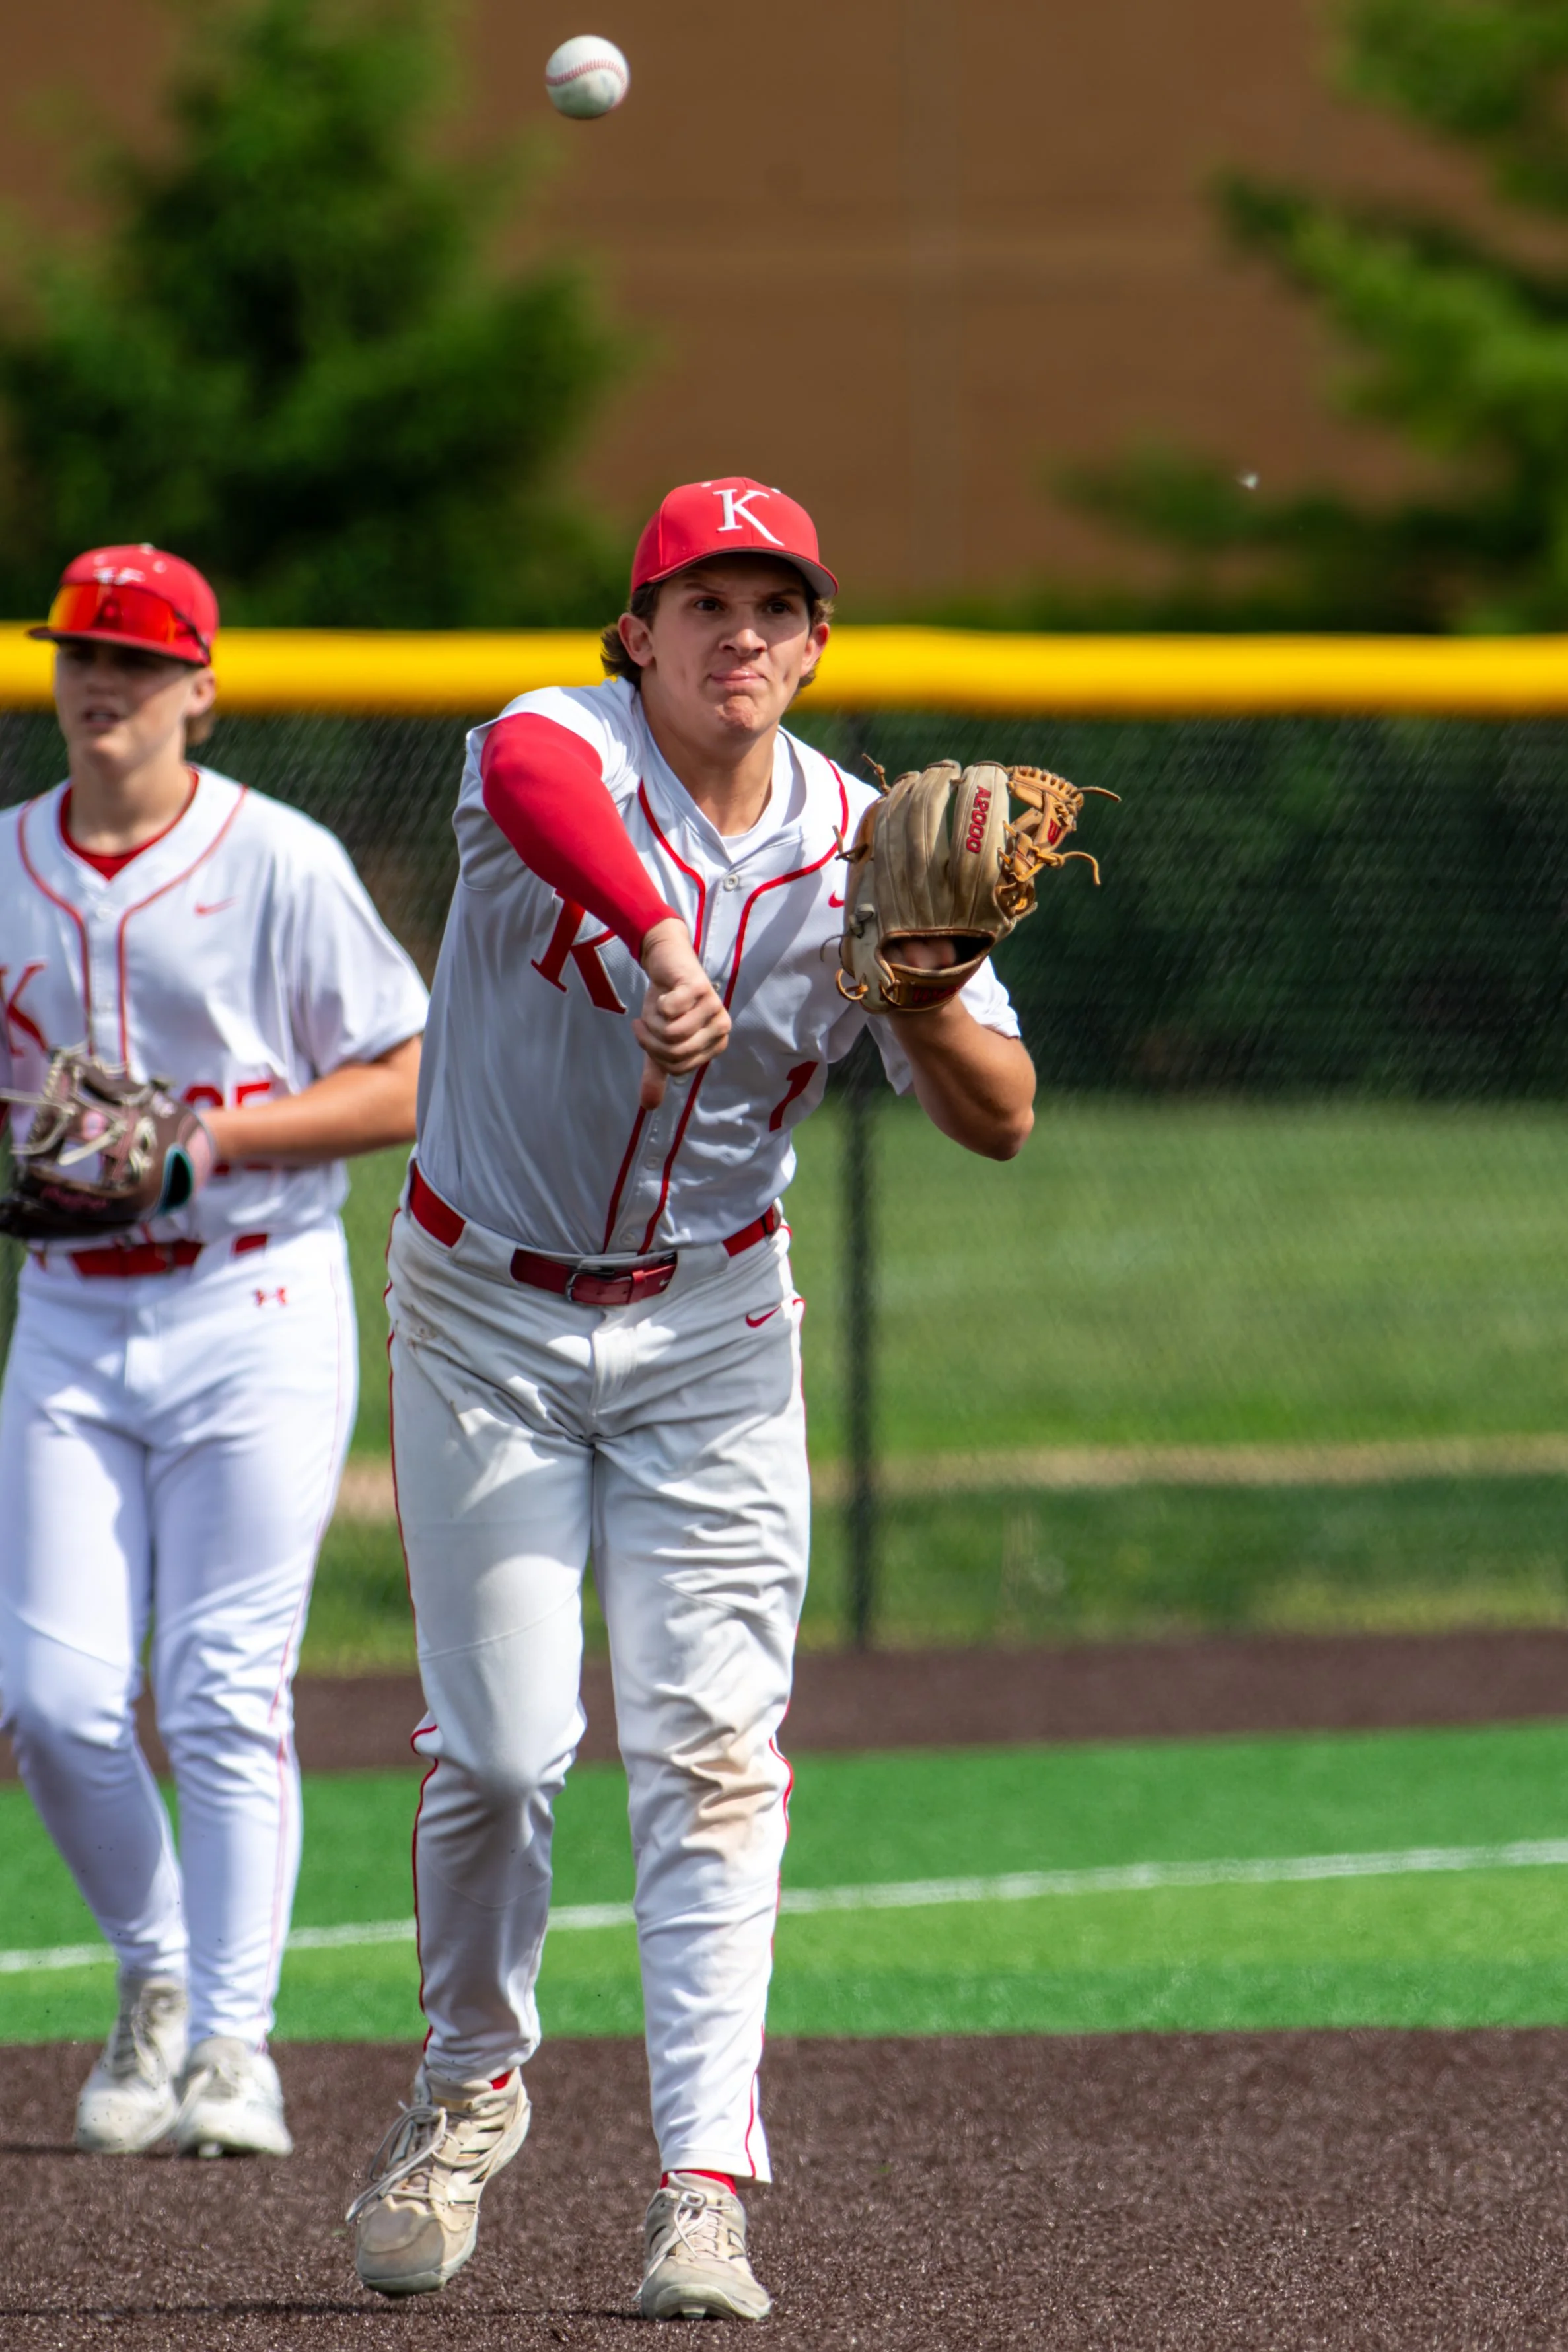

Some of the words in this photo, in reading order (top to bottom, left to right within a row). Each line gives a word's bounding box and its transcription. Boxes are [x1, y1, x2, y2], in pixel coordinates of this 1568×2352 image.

[713, 489, 785, 546] K
[966, 785, 991, 854] A2000
[531, 888, 629, 1015] K
[769, 1061, 818, 1133] 1
